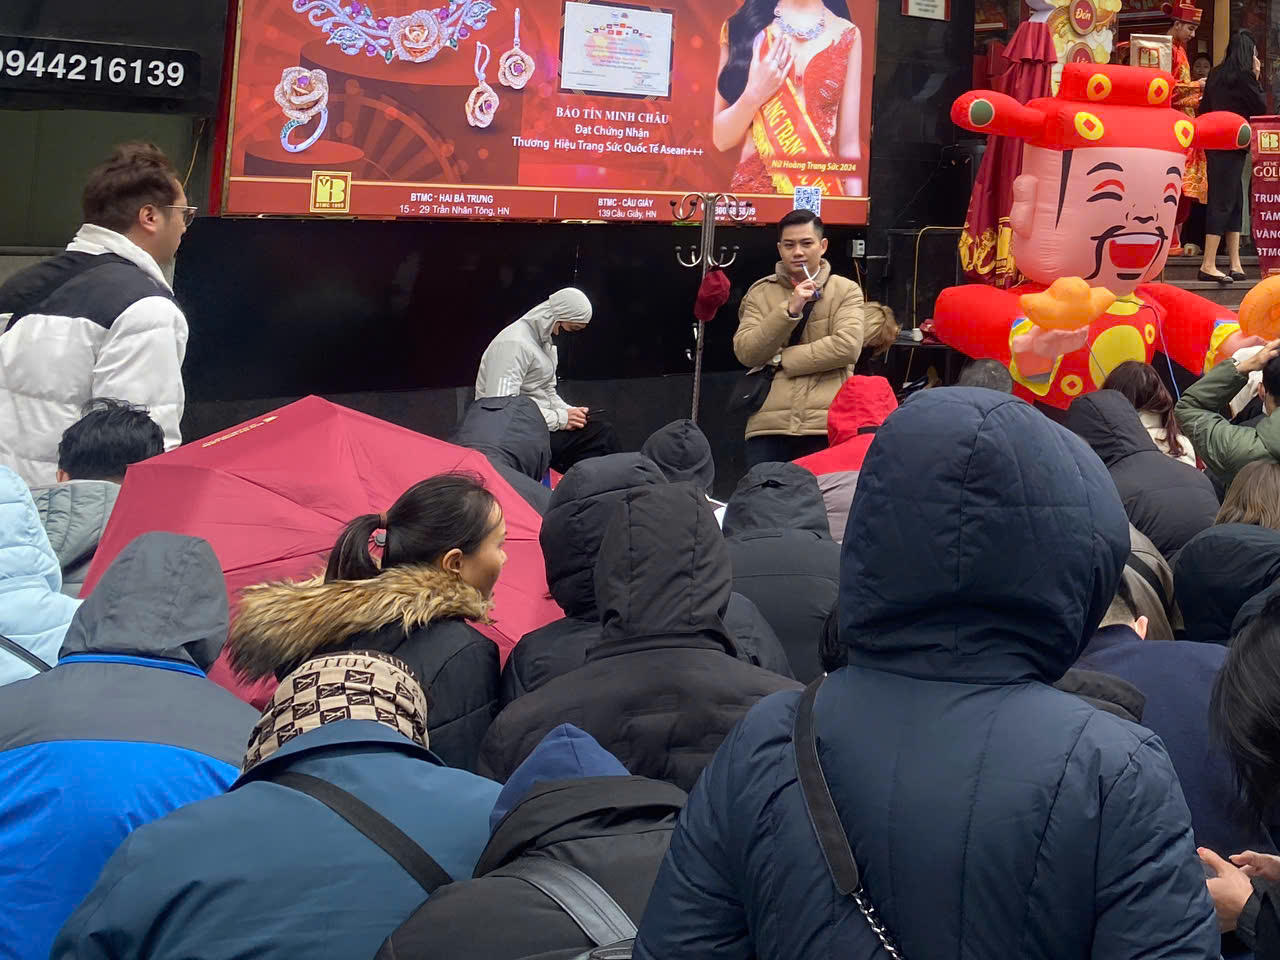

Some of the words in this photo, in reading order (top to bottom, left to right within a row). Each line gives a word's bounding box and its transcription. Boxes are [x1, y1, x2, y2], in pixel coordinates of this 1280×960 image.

[1075, 11, 1091, 21] Đón
[0, 48, 185, 88] 944216139
[575, 124, 592, 136] Đạt
[593, 125, 624, 138] Chứng
[626, 127, 649, 139] Nhận
[511, 136, 550, 150] Thương
[554, 138, 576, 152] Hiệu
[577, 140, 604, 153] Trang
[605, 141, 622, 152] Sức
[624, 142, 648, 154] Quốc
[648, 143, 660, 154] Tế
[660, 146, 704, 156] Asean+++
[1260, 211, 1280, 221] TÂM
